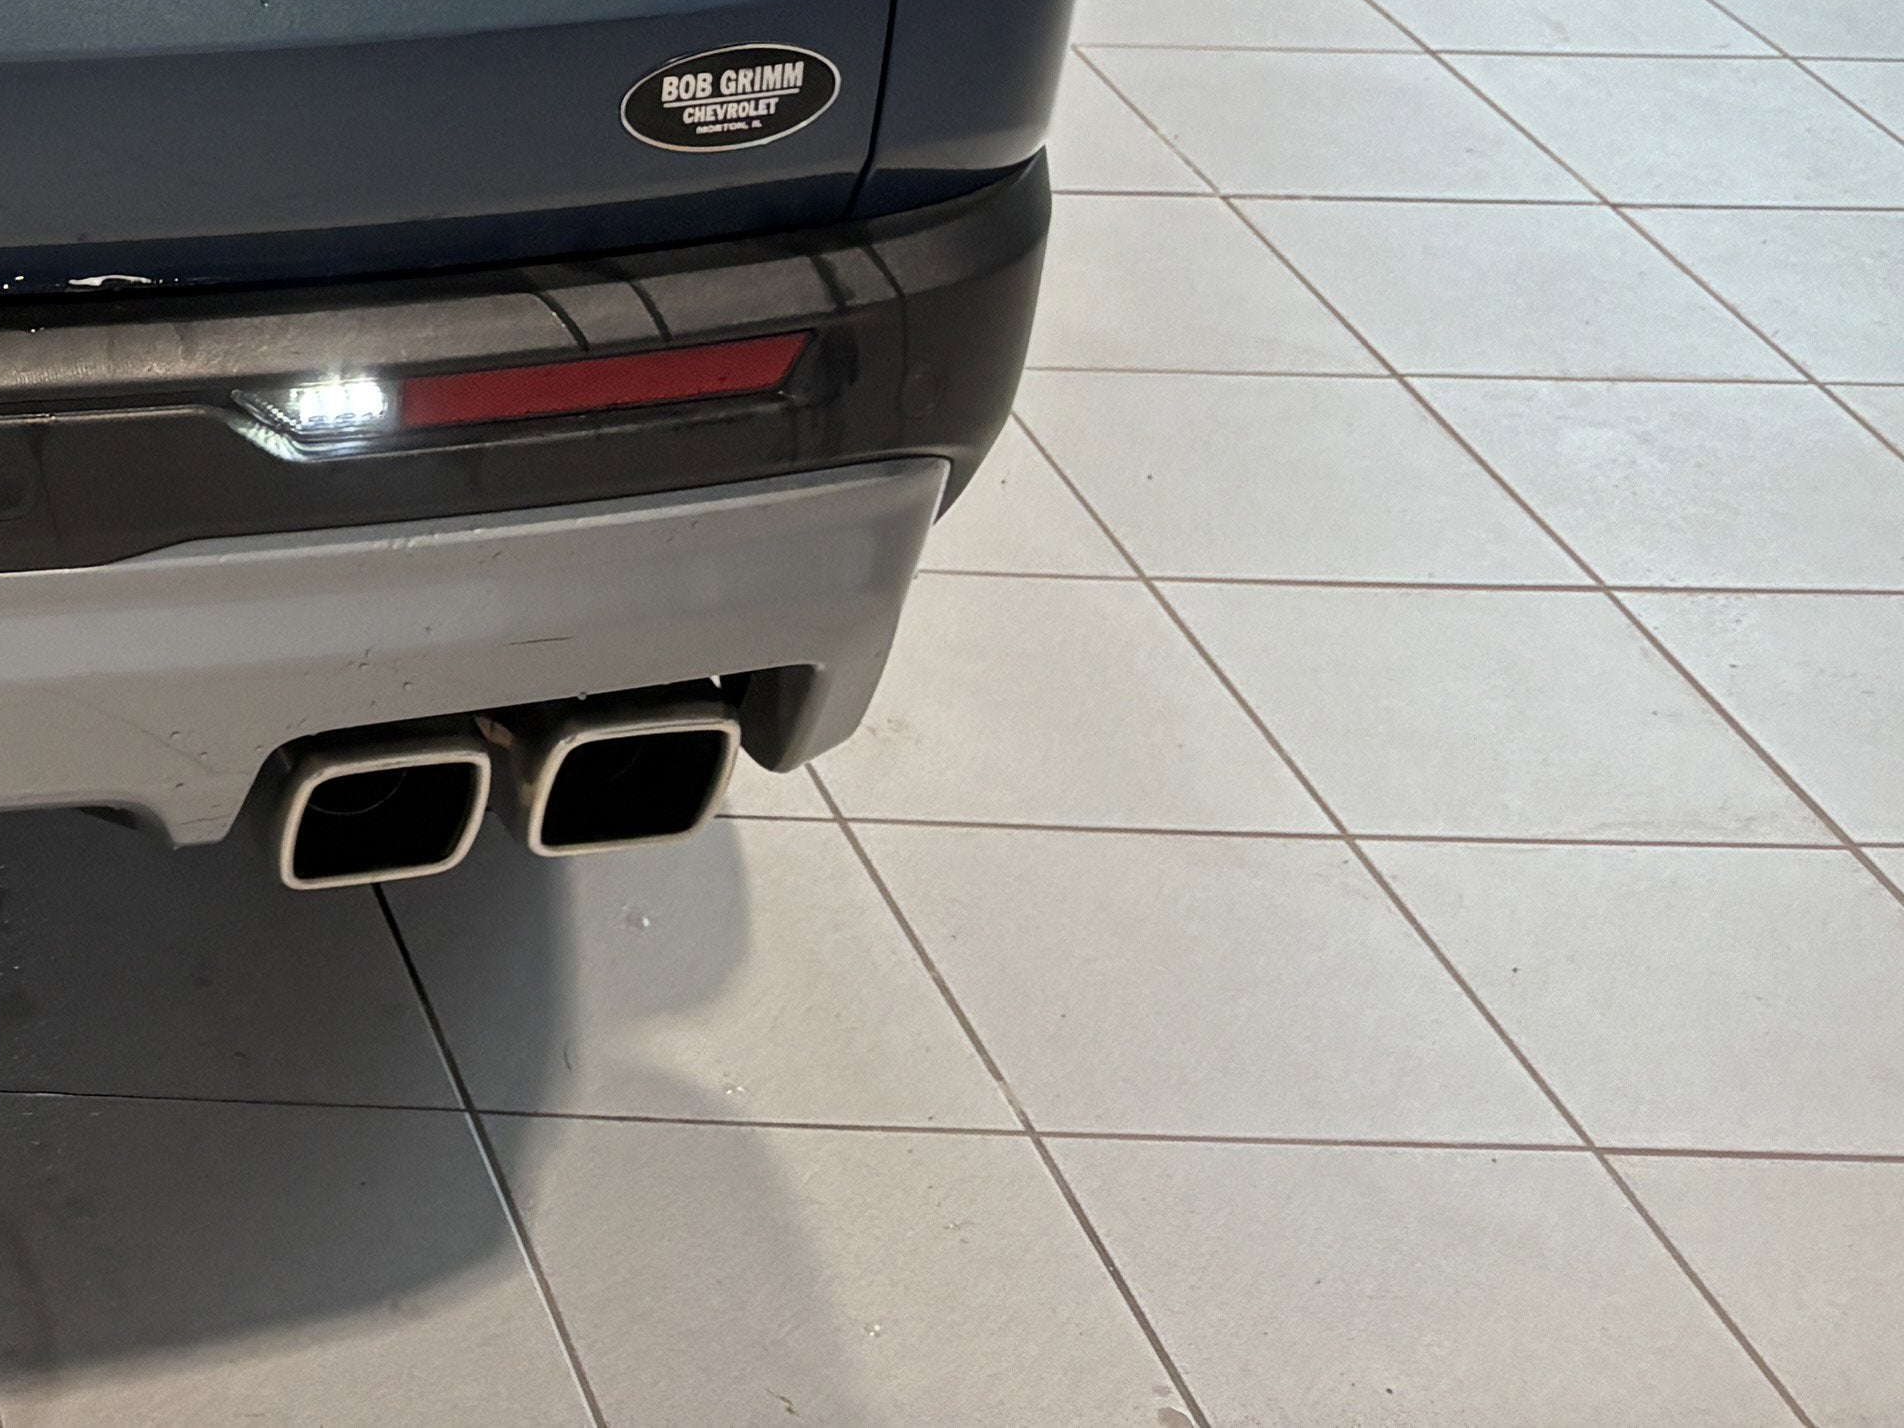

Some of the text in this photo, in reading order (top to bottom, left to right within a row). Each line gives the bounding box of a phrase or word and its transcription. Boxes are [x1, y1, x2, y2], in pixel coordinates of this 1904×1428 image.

[661, 60, 805, 102] BOB GRIMM
[682, 97, 780, 124] CHEVROLET
